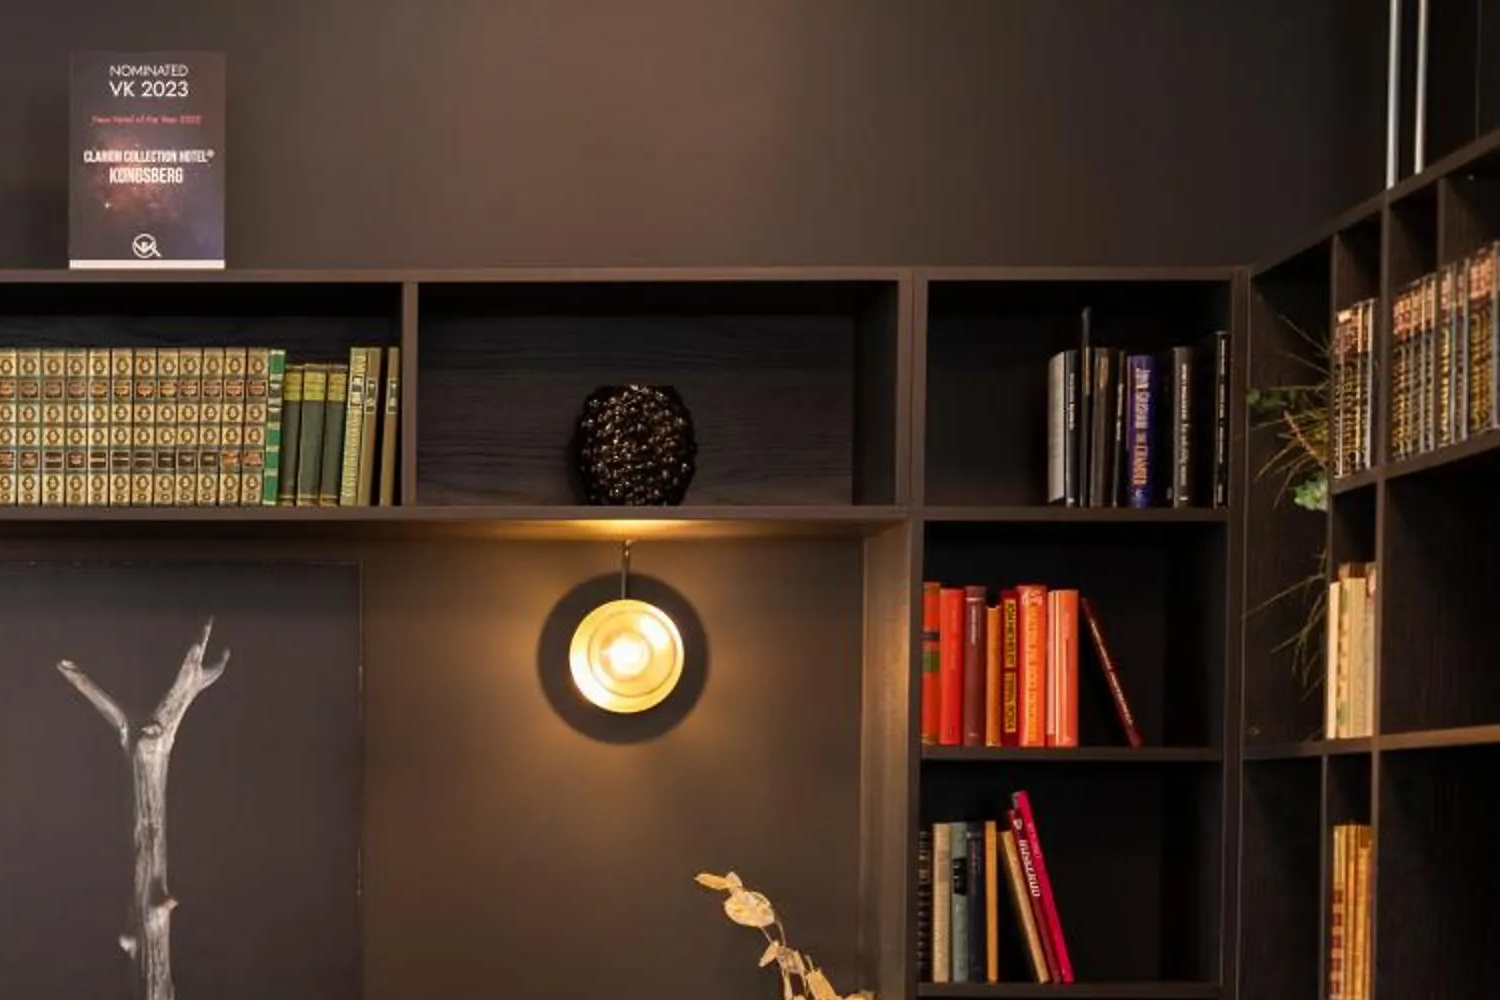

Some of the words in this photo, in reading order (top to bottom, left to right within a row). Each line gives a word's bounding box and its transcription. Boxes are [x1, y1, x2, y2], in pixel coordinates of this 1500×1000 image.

[109, 63, 189, 77] NOMINATED
[109, 81, 135, 97] VK
[141, 81, 189, 97] 2023
[83, 149, 122, 163] CLARION
[123, 149, 177, 163] COLLECTION
[109, 167, 183, 184] KONGSBERG
